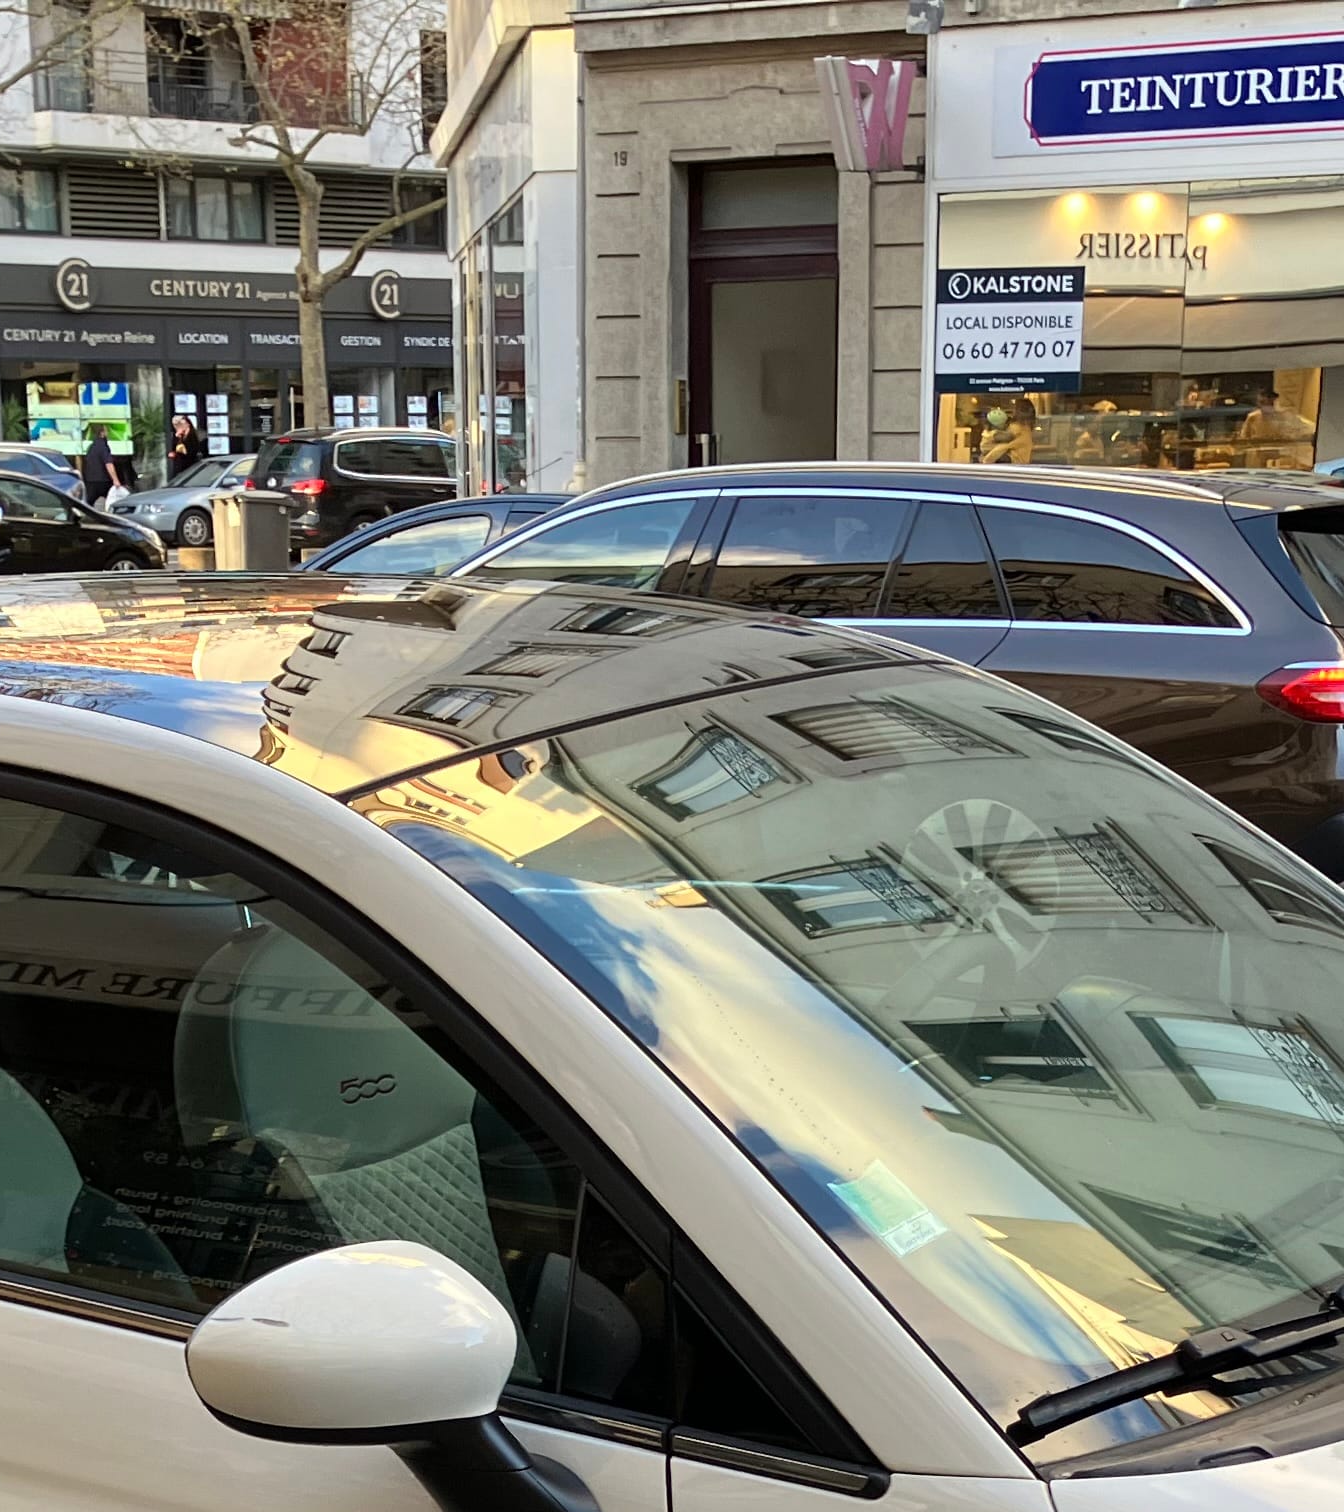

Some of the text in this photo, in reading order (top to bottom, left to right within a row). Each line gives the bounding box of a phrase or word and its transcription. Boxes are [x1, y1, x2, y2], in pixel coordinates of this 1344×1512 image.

[613, 151, 628, 167] 19
[150, 279, 231, 298] CENTURY
[234, 282, 250, 299] 21
[972, 274, 1075, 294] KALSTONE
[946, 315, 1073, 330] LOCAL DISPONIBLE
[3, 328, 61, 341] CENTURY
[81, 331, 122, 346] Agence
[179, 332, 229, 345] LOCATION
[340, 335, 382, 346] GESTION
[404, 336, 437, 347] SYNDIC
[942, 340, 1075, 360] 06 60 47 70 07
